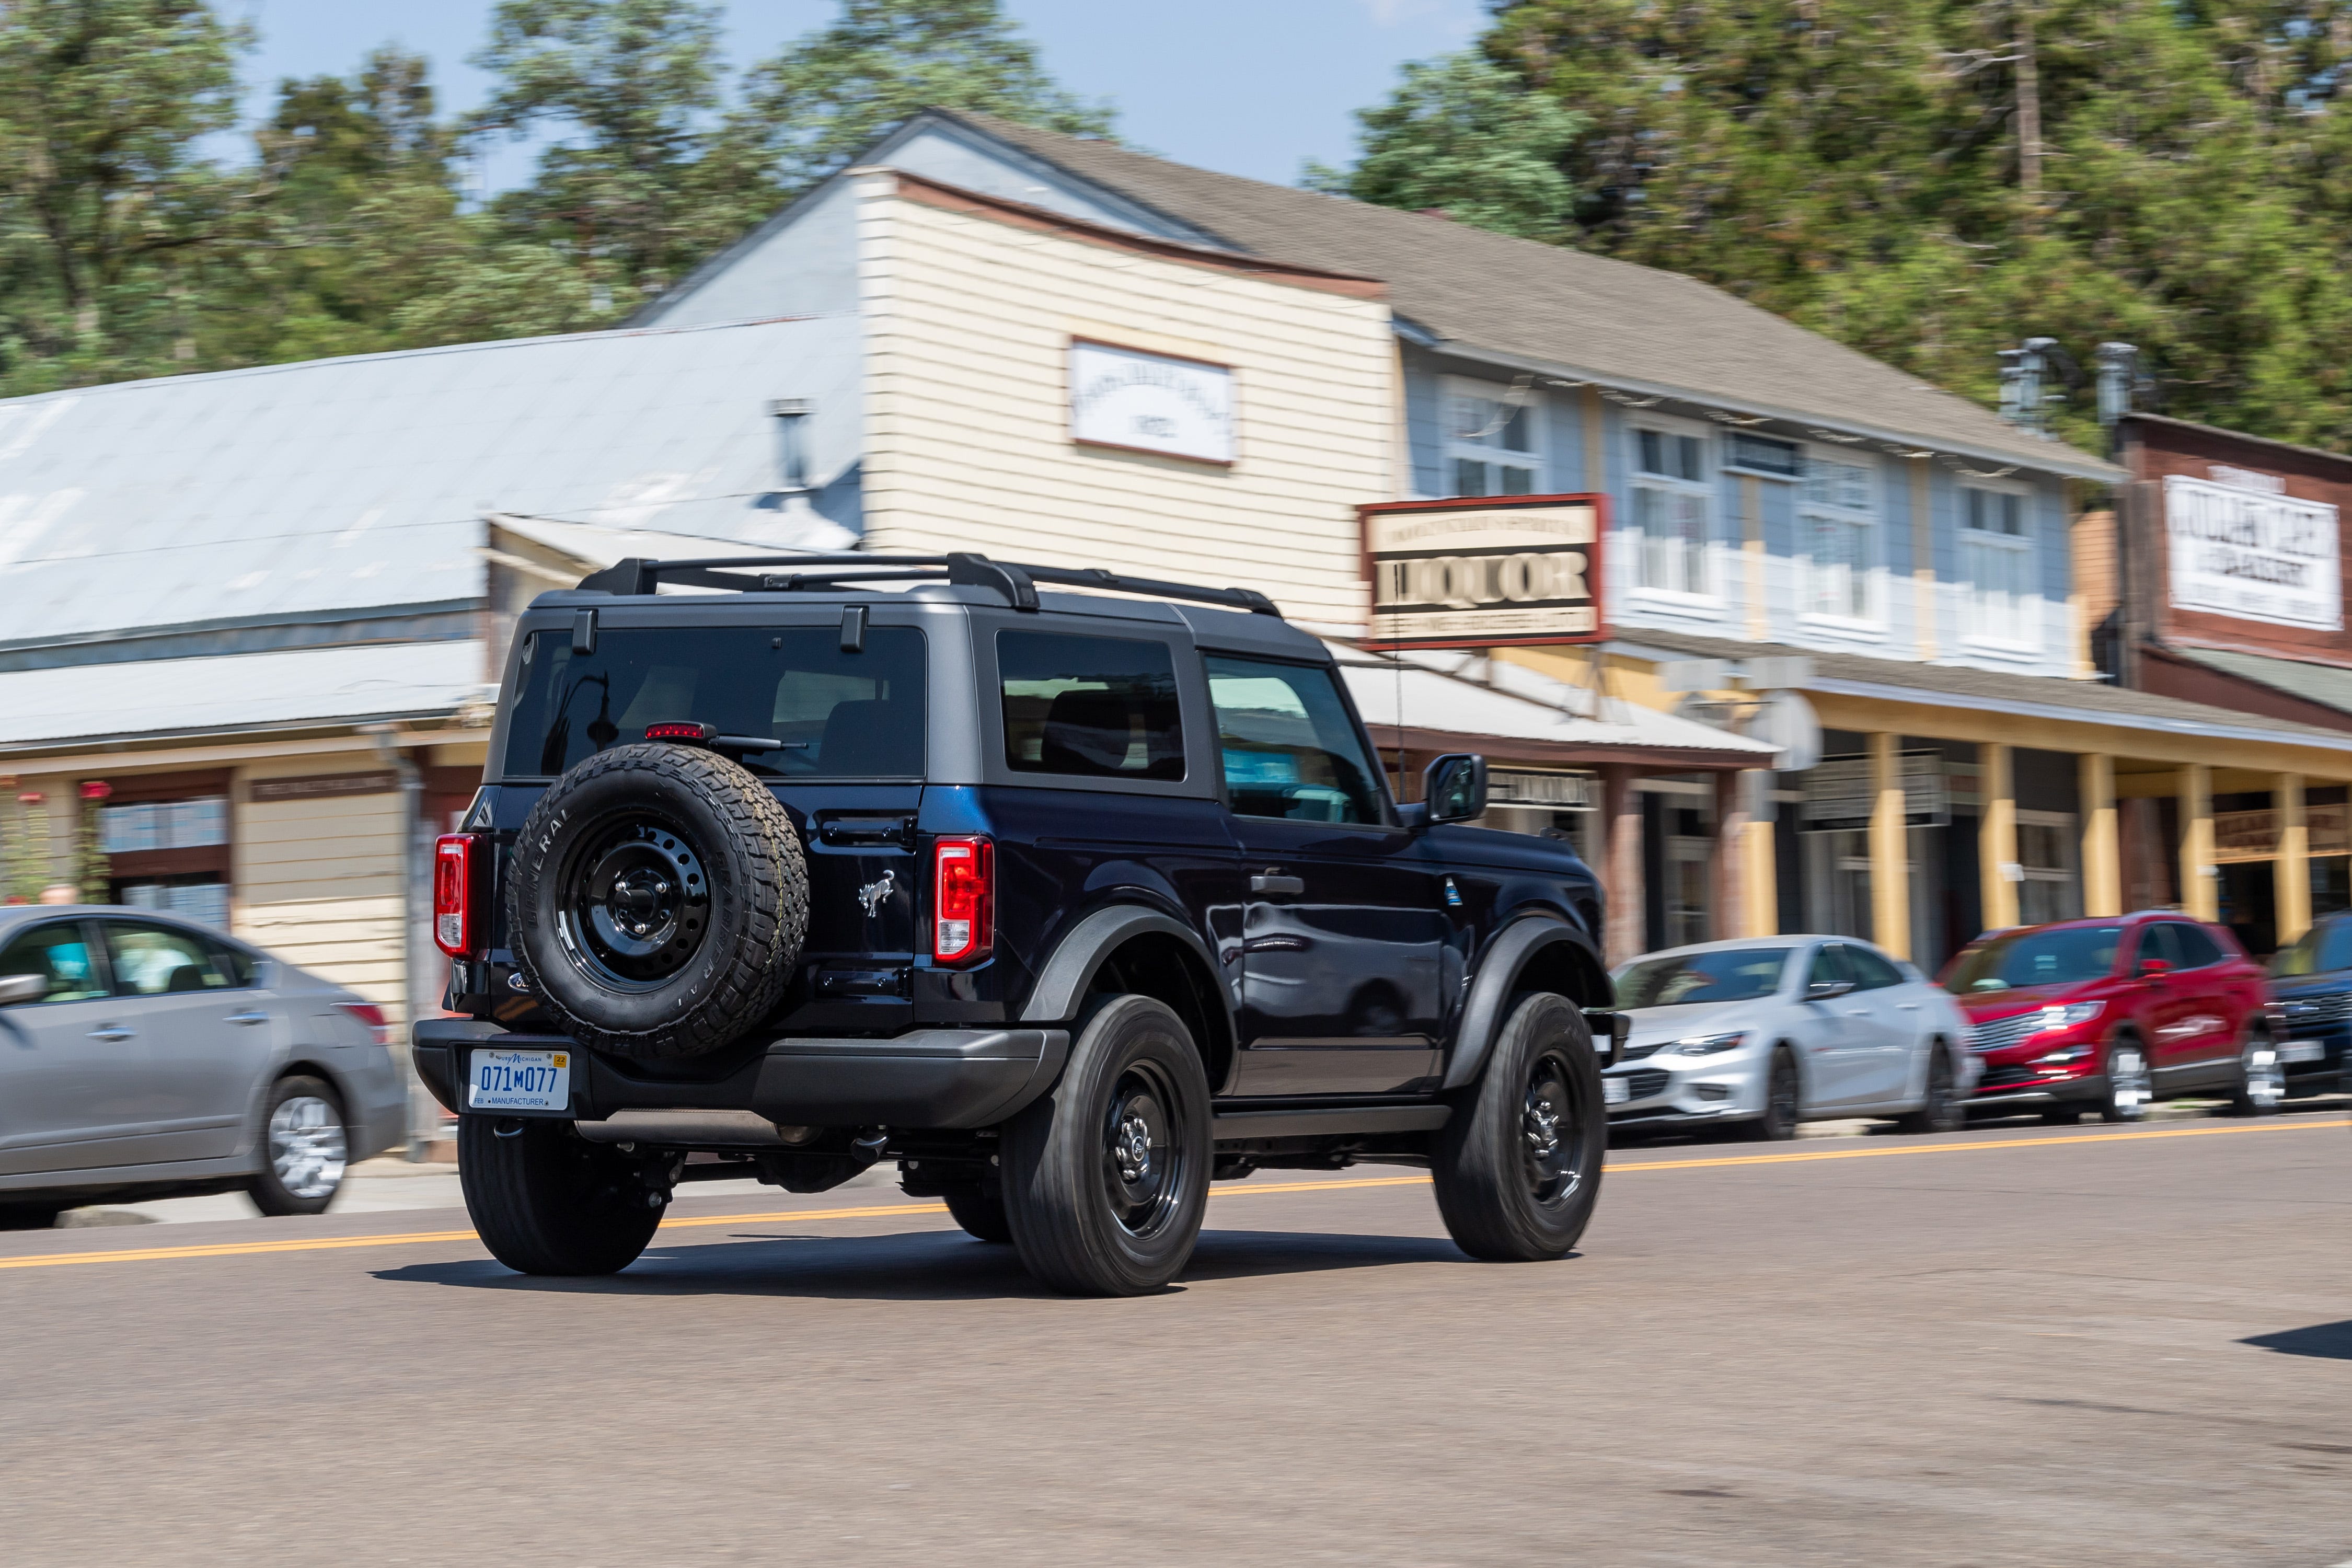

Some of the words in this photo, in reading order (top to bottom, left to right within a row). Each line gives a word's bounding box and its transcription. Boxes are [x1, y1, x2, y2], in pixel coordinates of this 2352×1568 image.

[526, 809, 573, 928] GENERAL
[506, 1053, 542, 1065] MICHIGAN
[481, 1066, 557, 1092] 071M077
[492, 1097, 544, 1105] MANUFACTURER
